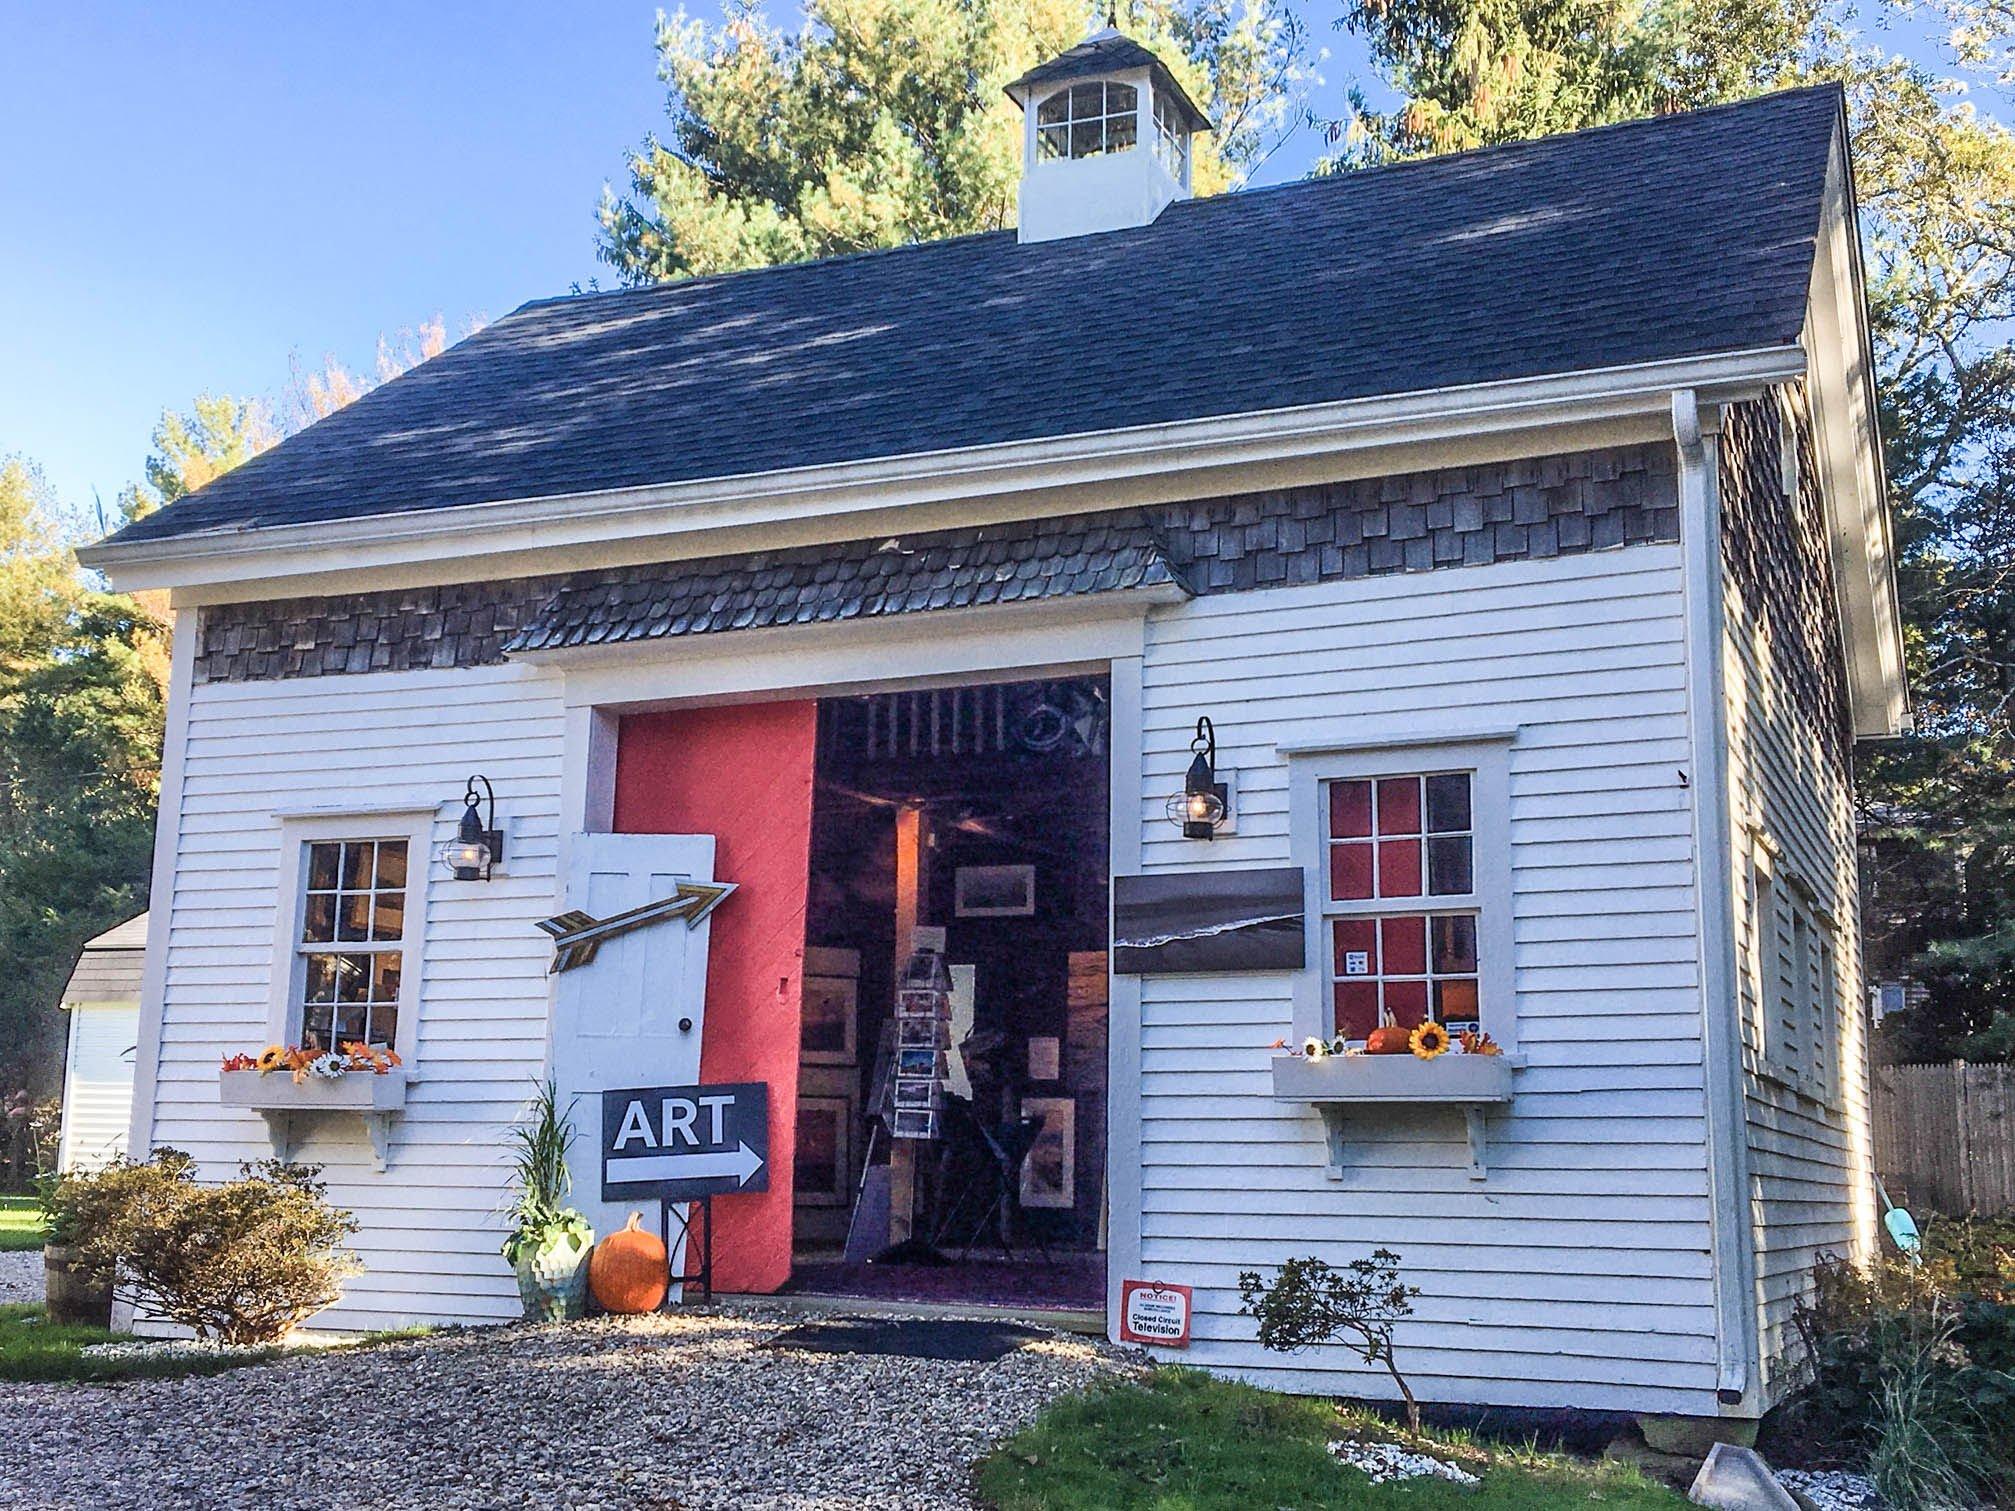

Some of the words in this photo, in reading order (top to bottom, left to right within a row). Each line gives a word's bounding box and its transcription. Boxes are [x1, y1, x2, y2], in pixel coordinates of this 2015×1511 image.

[613, 1095, 735, 1150] ART
[1140, 1292, 1177, 1302] NOTICE!
[1132, 1313, 1156, 1323] Closed
[1159, 1316, 1181, 1325] Circuit
[1132, 1321, 1180, 1336] Television
